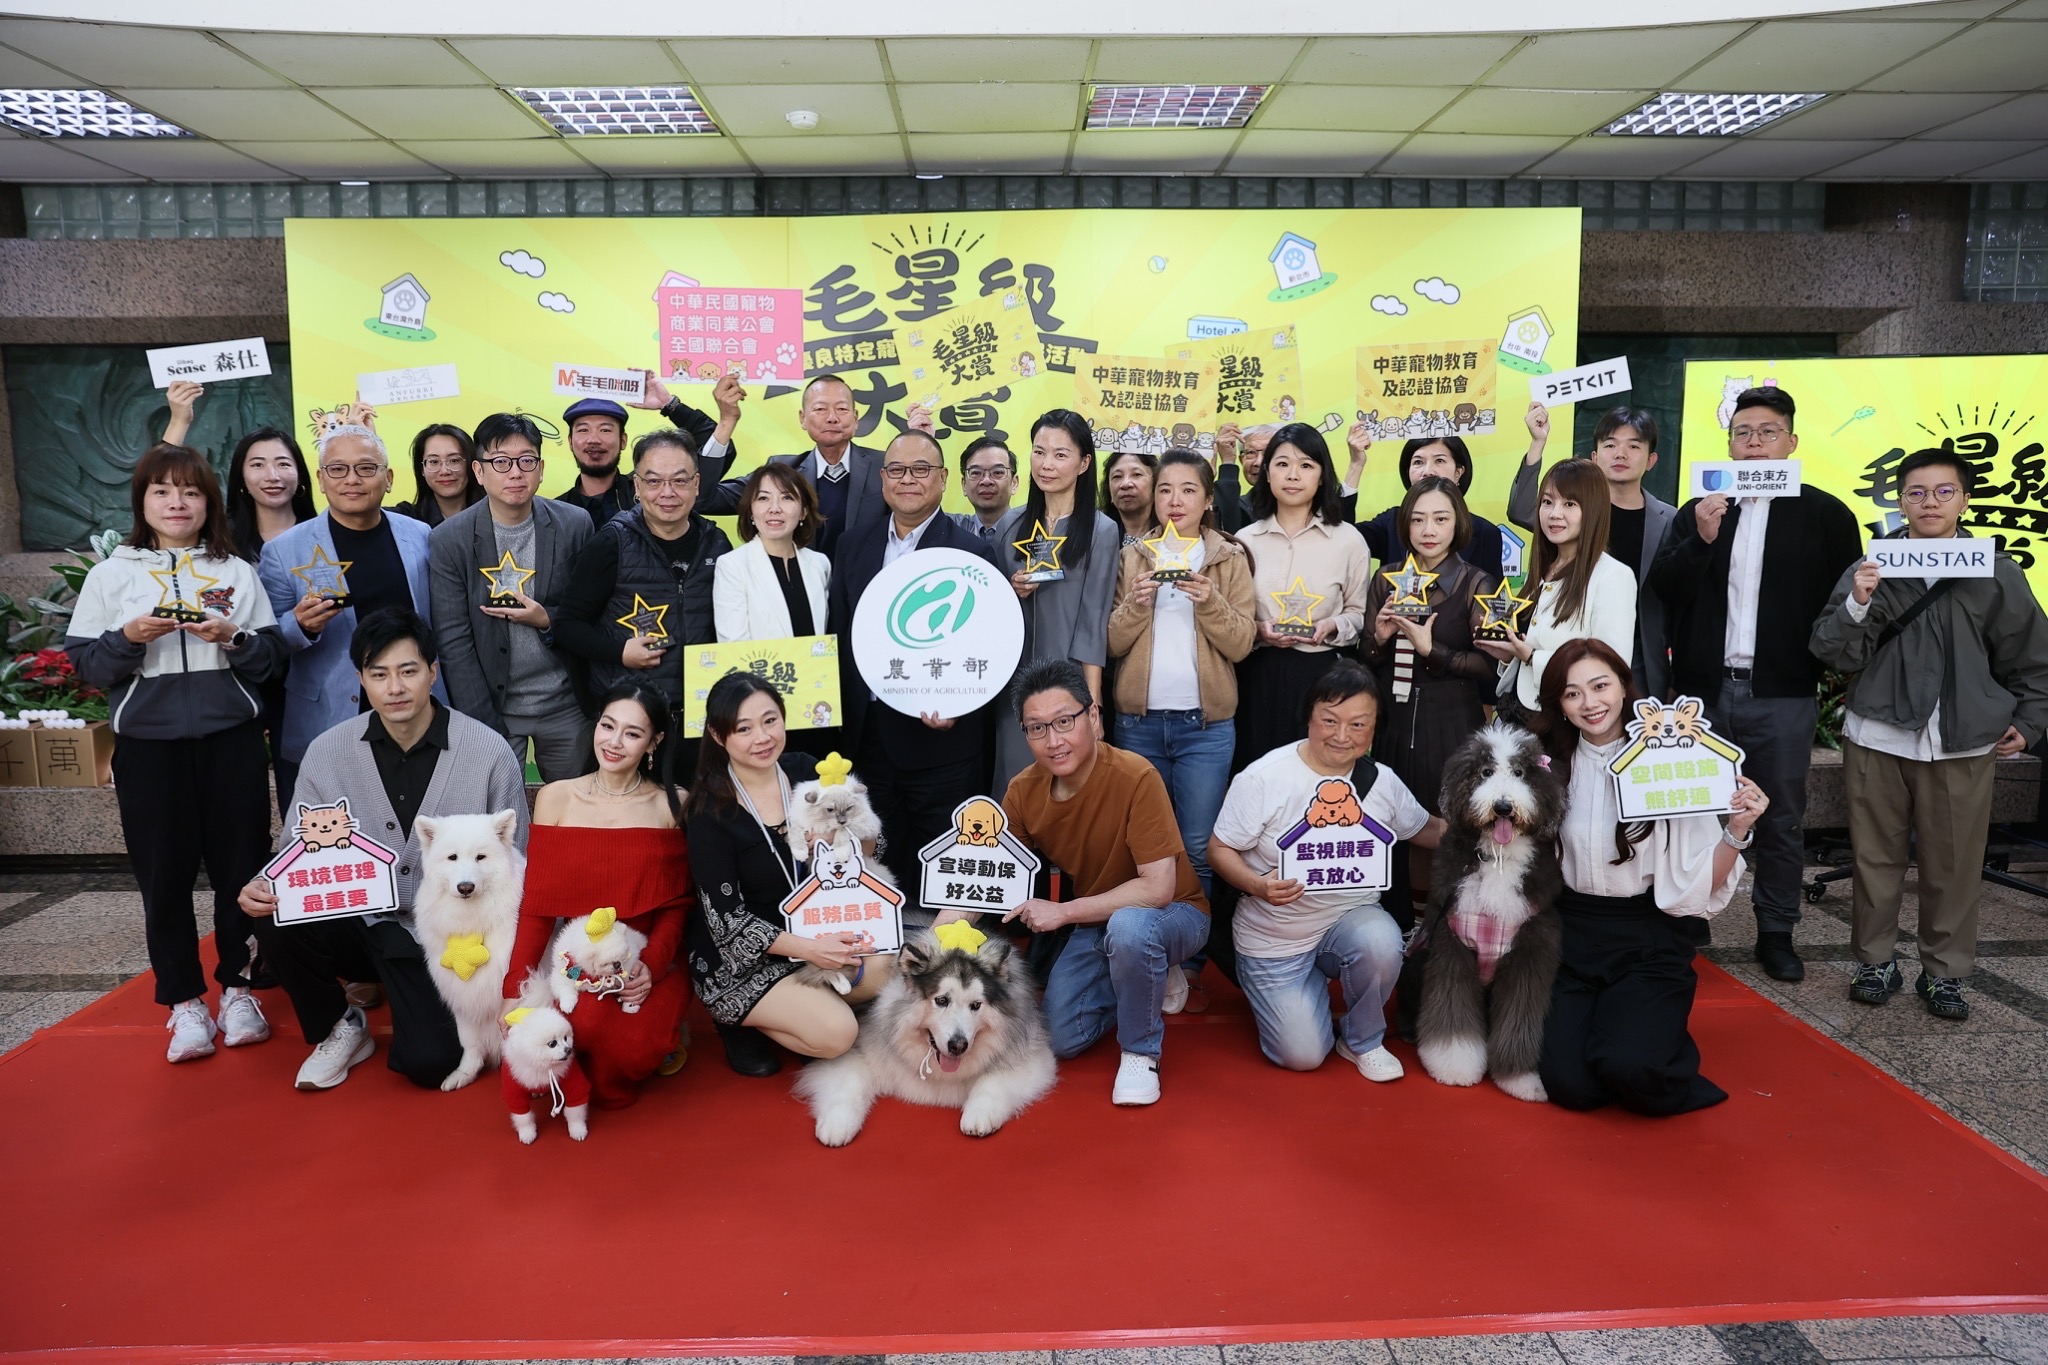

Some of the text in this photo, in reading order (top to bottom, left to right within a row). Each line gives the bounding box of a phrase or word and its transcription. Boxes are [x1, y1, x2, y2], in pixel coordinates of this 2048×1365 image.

[803, 248, 1065, 332] 毛星級
[669, 293, 775, 312] 中華民國寵物
[669, 315, 775, 334] 商業同業公會
[1196, 324, 1227, 336] Hotel
[670, 336, 758, 355] 全國聯合會
[932, 321, 999, 361] 毛星級
[1506, 342, 1521, 352] 台中
[166, 362, 207, 376] Sense
[213, 349, 260, 373] 森仕
[951, 353, 996, 386] 大賞
[1373, 351, 1478, 375] 中華寵物教育
[1092, 365, 1200, 390] 中華寵物教育
[1382, 374, 1469, 398] 及認證協會
[1546, 369, 1616, 399] PETKIT
[1099, 389, 1189, 413] 及認證協會
[1216, 388, 1256, 414] 大賞
[1737, 470, 1788, 482] 聯合東方
[1737, 483, 1788, 491] UNI-ORIENT
[1876, 551, 1986, 568] SUNSTAR
[883, 657, 989, 680] 農業部
[882, 686, 988, 695] MINISTRY OF AGRICULTURE
[1631, 758, 1720, 785] 空間設施
[1296, 839, 1375, 861] 監視觀看
[287, 861, 377, 889] 環境管理
[938, 856, 1016, 879] 宣導動保
[1306, 866, 1366, 886] 真放心
[303, 888, 369, 914] 最重要
[945, 882, 1004, 904] 好公益
[803, 901, 883, 926] 服務品質
